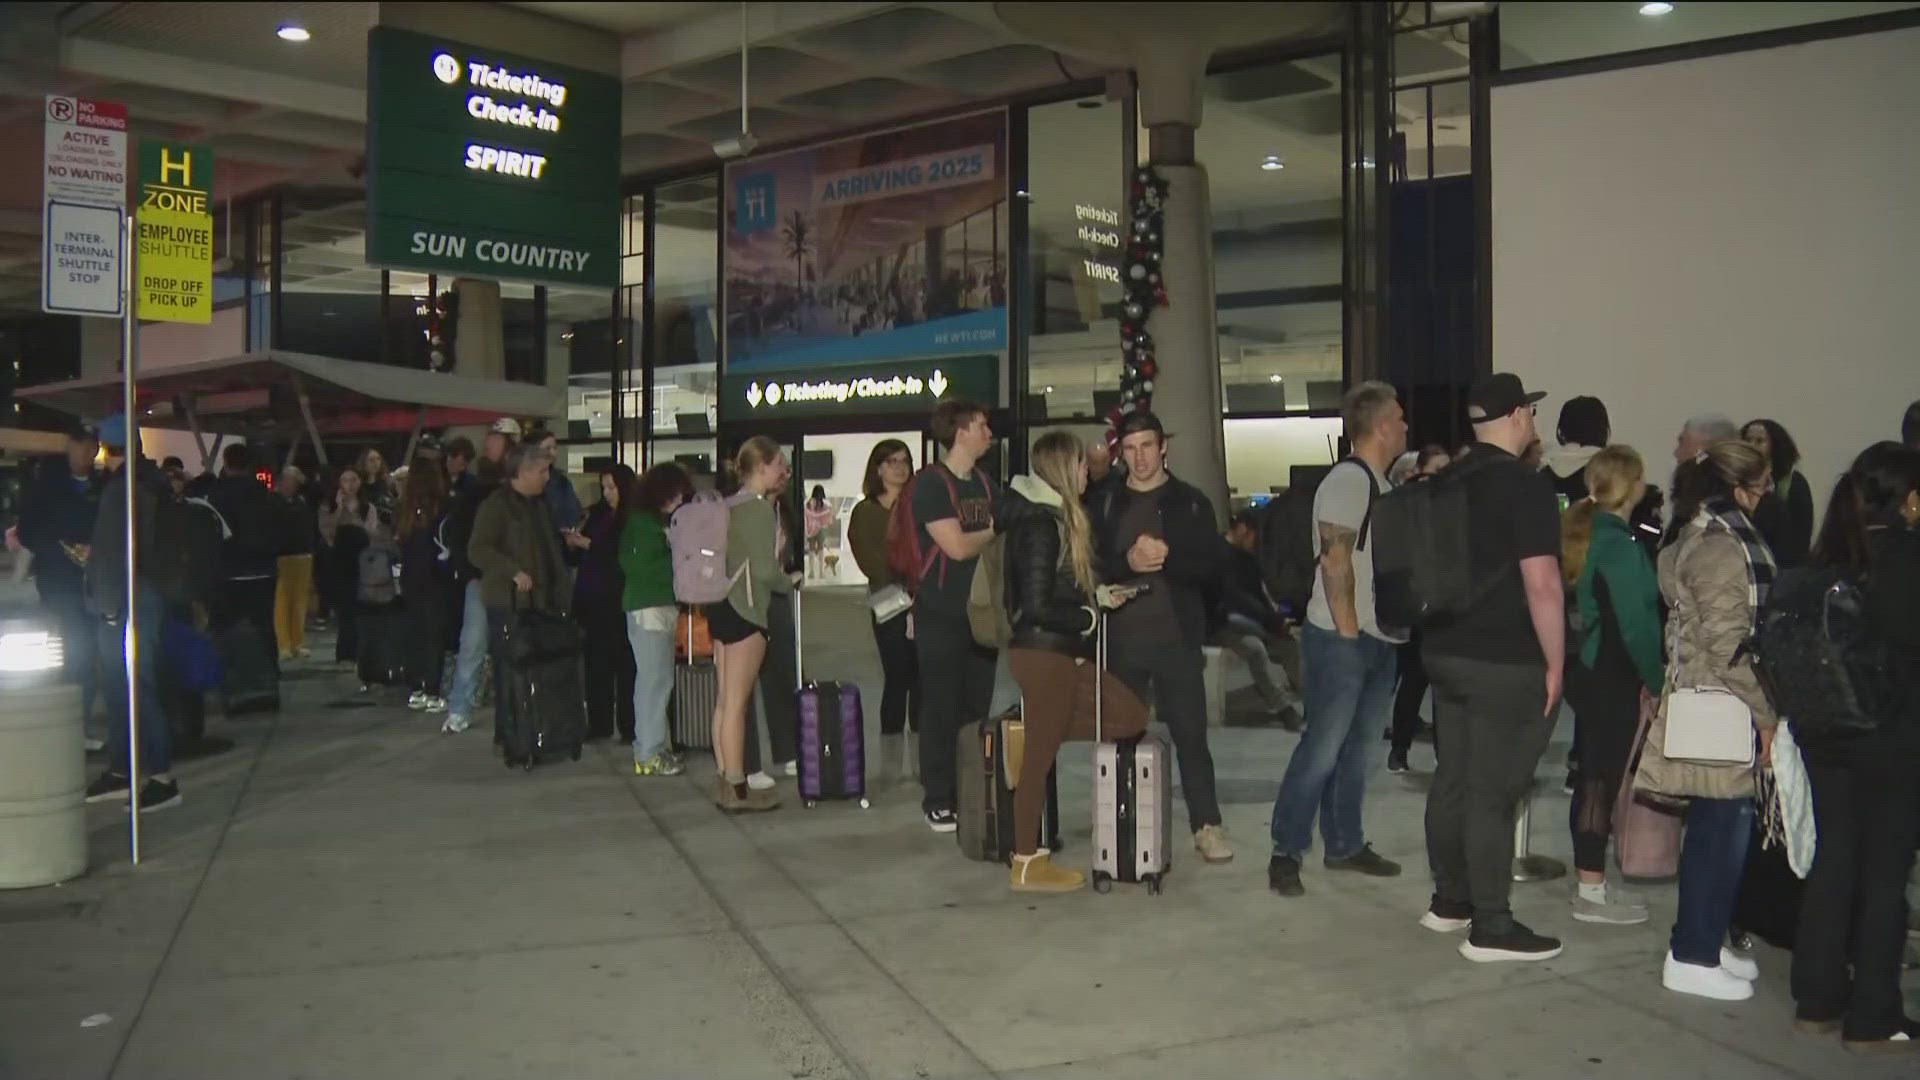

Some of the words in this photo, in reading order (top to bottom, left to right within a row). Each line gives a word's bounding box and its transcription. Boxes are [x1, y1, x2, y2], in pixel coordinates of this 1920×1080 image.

[469, 62, 566, 107] Ticketing
[79, 101, 96, 113] NO
[467, 95, 560, 132] Check-In
[79, 113, 126, 128] PARKING
[63, 131, 110, 146] ACTIVE
[160, 148, 191, 187] H
[465, 144, 547, 178] SPIRIT
[48, 165, 67, 177] NO
[70, 168, 124, 185] WAITING
[823, 165, 923, 201] ARRIVING
[929, 154, 983, 182] 2025
[143, 191, 207, 215] ZONE
[140, 223, 209, 246] EMPLOYEE
[54, 244, 116, 259] TERMINAL
[140, 243, 208, 261] SHUTTLE
[411, 232, 466, 258] SUN
[475, 240, 590, 272] COUNTRY
[58, 258, 111, 272] SHUTTLE
[68, 272, 100, 284] STOP
[144, 276, 177, 291] DROP
[181, 279, 203, 292] OFF
[150, 293, 179, 307] PICK
[183, 296, 198, 308] UP
